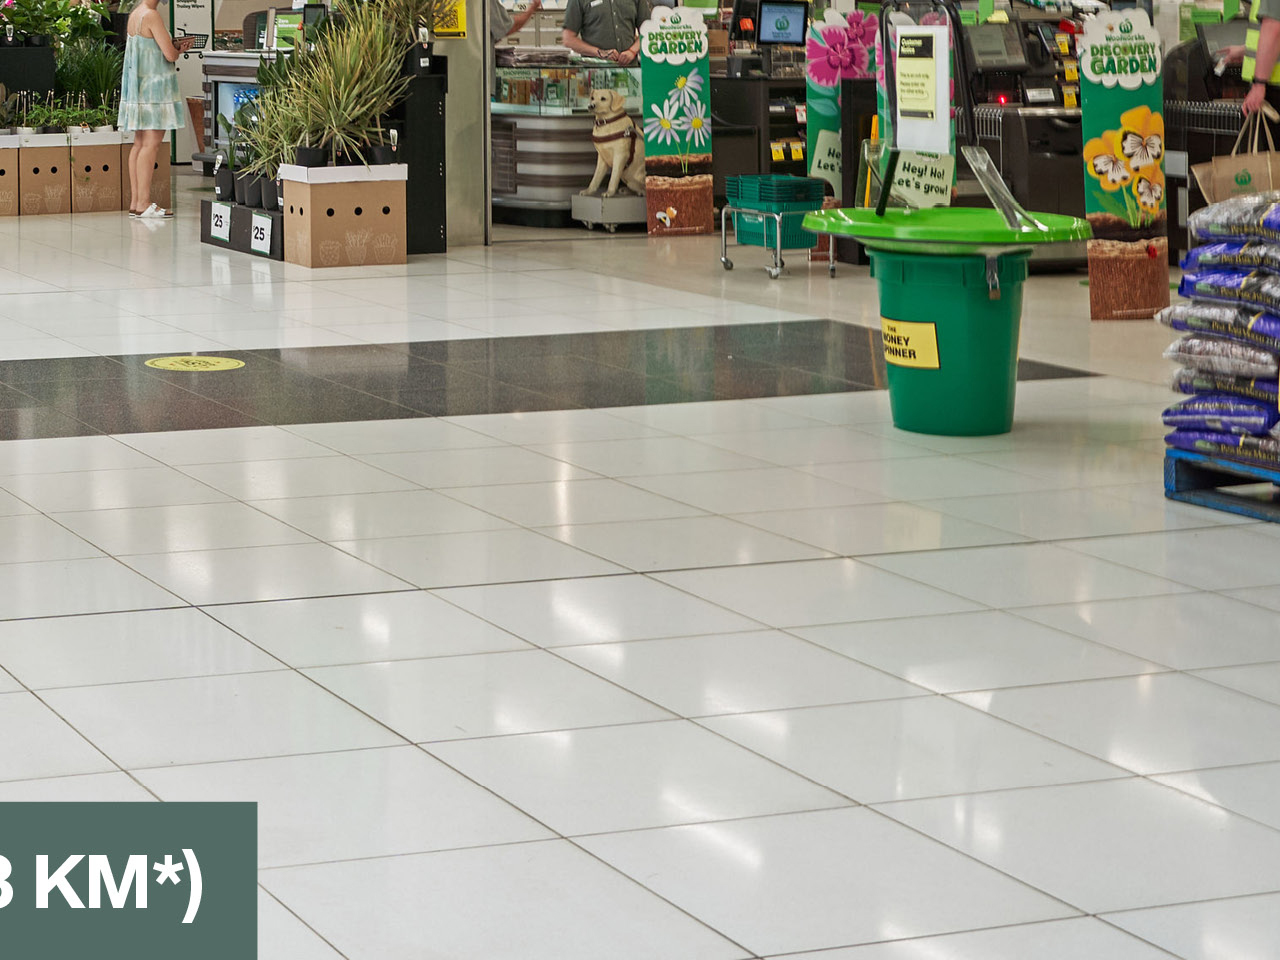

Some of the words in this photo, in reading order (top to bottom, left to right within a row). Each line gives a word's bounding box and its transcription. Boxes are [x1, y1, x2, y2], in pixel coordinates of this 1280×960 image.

[648, 31, 701, 41] DISCOVERY
[1105, 34, 1146, 42] Woolworths
[648, 40, 702, 55] GARDEN
[1090, 43, 1156, 57] DISCOVERY
[1090, 55, 1157, 75] GARDEN
[902, 161, 927, 176] Hey!
[930, 164, 945, 180] Ho!
[892, 177, 921, 189] et's
[924, 181, 948, 197] grow!
